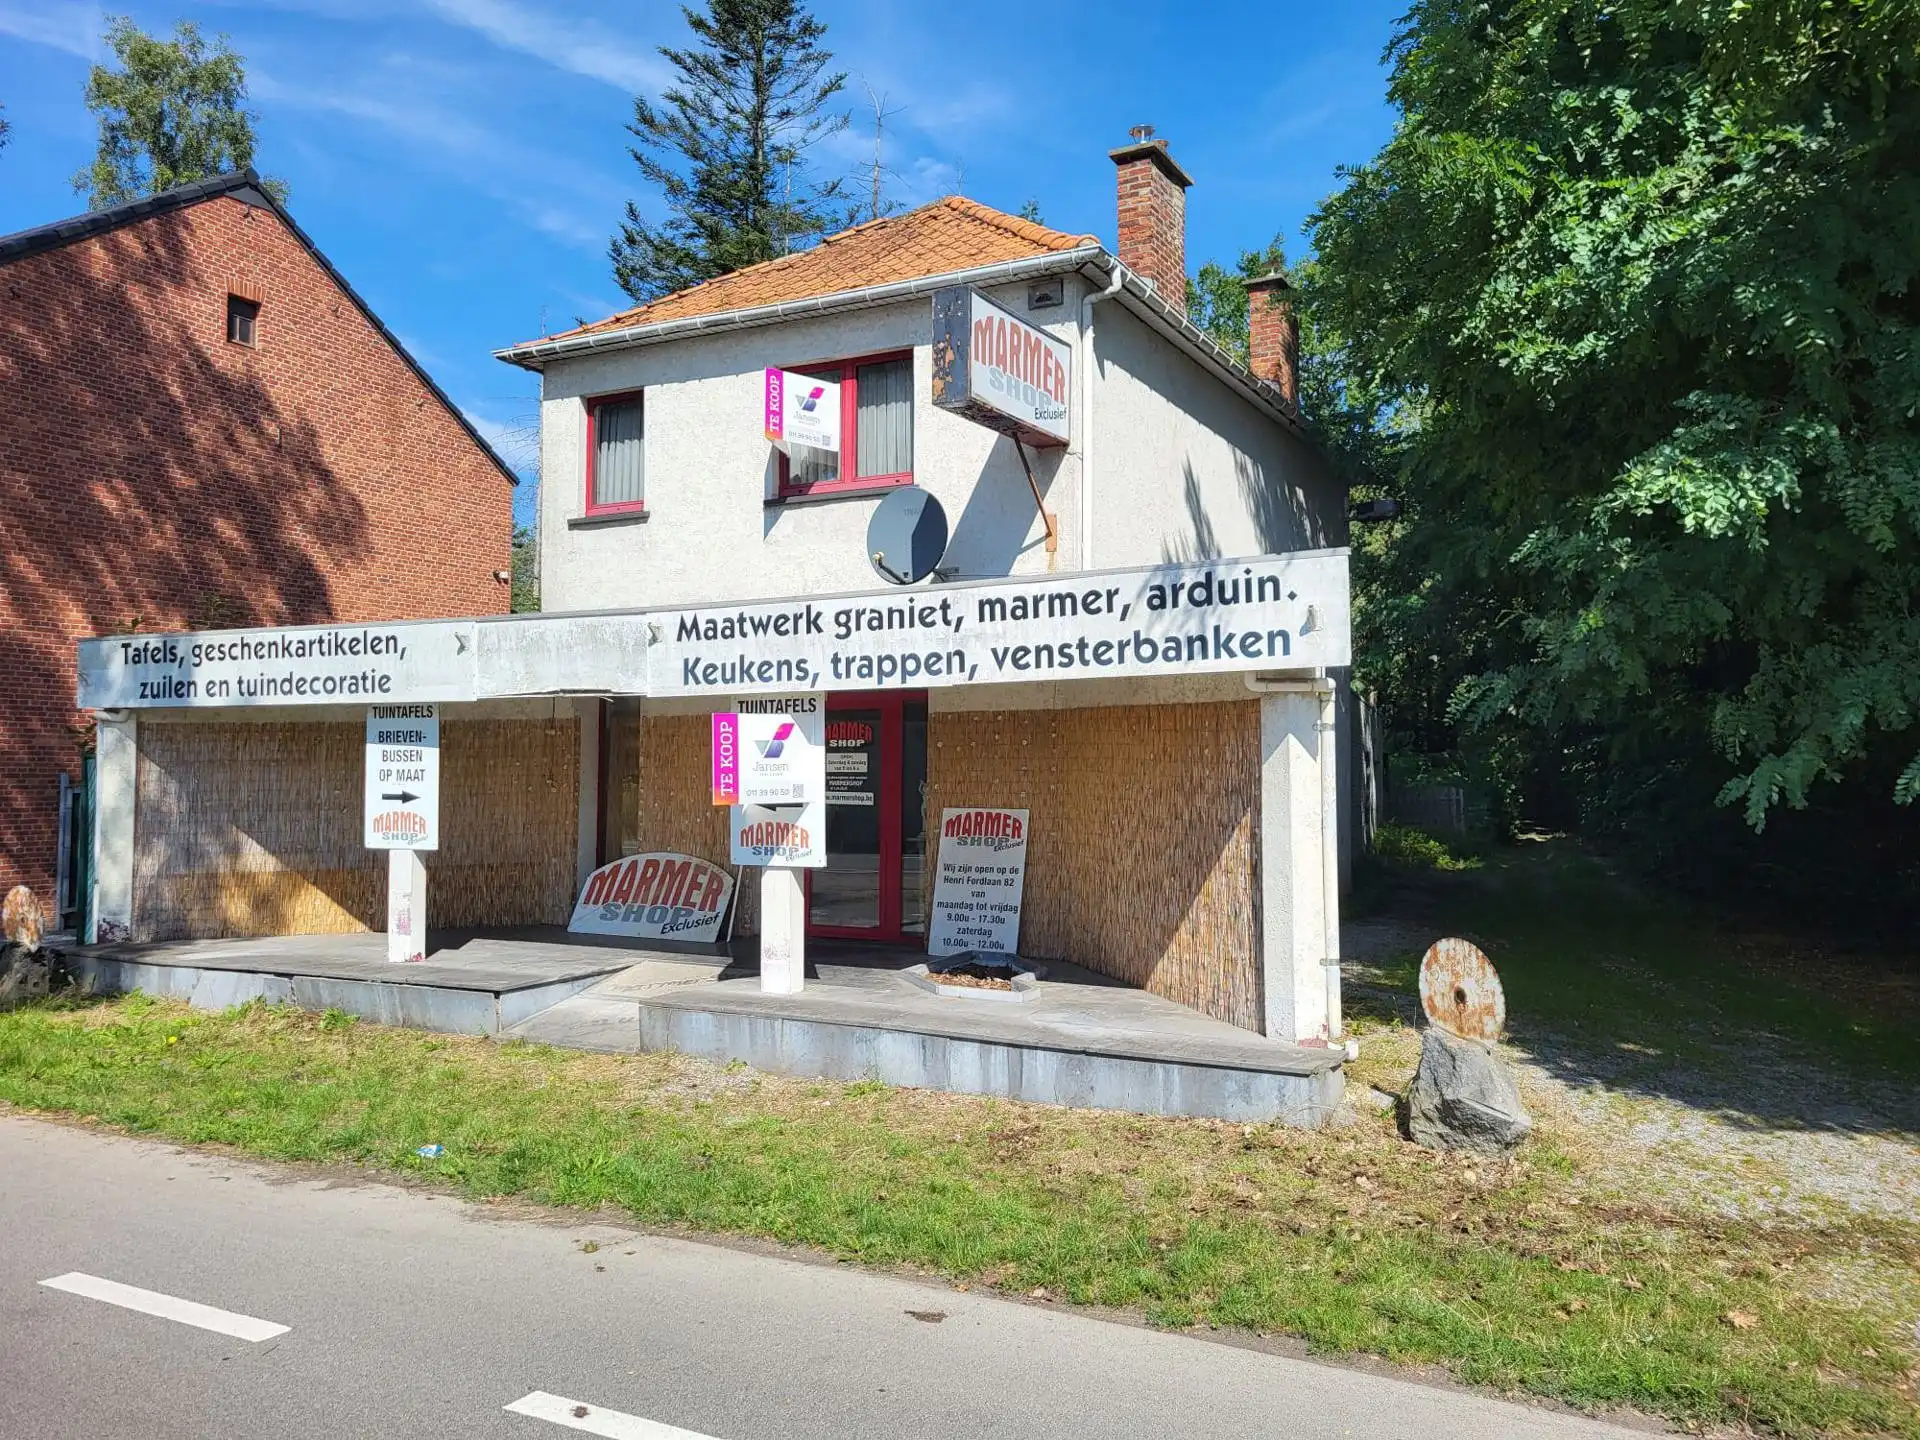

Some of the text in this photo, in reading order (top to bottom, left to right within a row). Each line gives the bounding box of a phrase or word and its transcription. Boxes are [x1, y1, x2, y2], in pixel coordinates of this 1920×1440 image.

[974, 316, 1066, 404] MARMER
[989, 367, 1052, 408] SHOP
[769, 375, 781, 432] TE KOOP
[1034, 407, 1067, 421] Exclusief
[676, 568, 1298, 642] Maatwerk graniet, marmer, arduin.
[121, 630, 407, 669] Tafels, geschenkartikelen,
[682, 624, 1291, 689] Keukens, trappen, vensterbanken
[139, 668, 392, 699] zuilen en tuindecoratie
[372, 704, 434, 719] TUINTAFELS
[738, 697, 817, 714] TUINTAFELS
[378, 730, 427, 743] BRIEVEN-
[828, 739, 866, 747] SHOP
[382, 749, 423, 762] BUSSEN
[720, 721, 734, 796] TE KOOP
[752, 760, 790, 772] Jansen
[379, 768, 426, 782] OP MAAT
[372, 811, 427, 834] MARMER
[945, 811, 1023, 839] MARMER
[382, 831, 419, 841] SHOP
[740, 821, 809, 848] MARMER
[957, 836, 1010, 847] SHOP
[752, 846, 800, 857] SHOP
[943, 863, 1020, 875] Wij zijn open op de
[583, 858, 725, 913] MARMER
[943, 875, 1015, 887] Henri Fordlaan 82
[971, 890, 986, 898] van
[599, 902, 694, 924] SHOP
[937, 900, 1019, 914] maandag tot vrijdag
[660, 911, 721, 935] Exclusief
[946, 912, 970, 923] 9.00u
[979, 913, 1006, 924] 17.30u
[956, 926, 993, 938] zaterdag
[942, 937, 969, 948] 10.00u
[977, 938, 1005, 950] 12.00u
